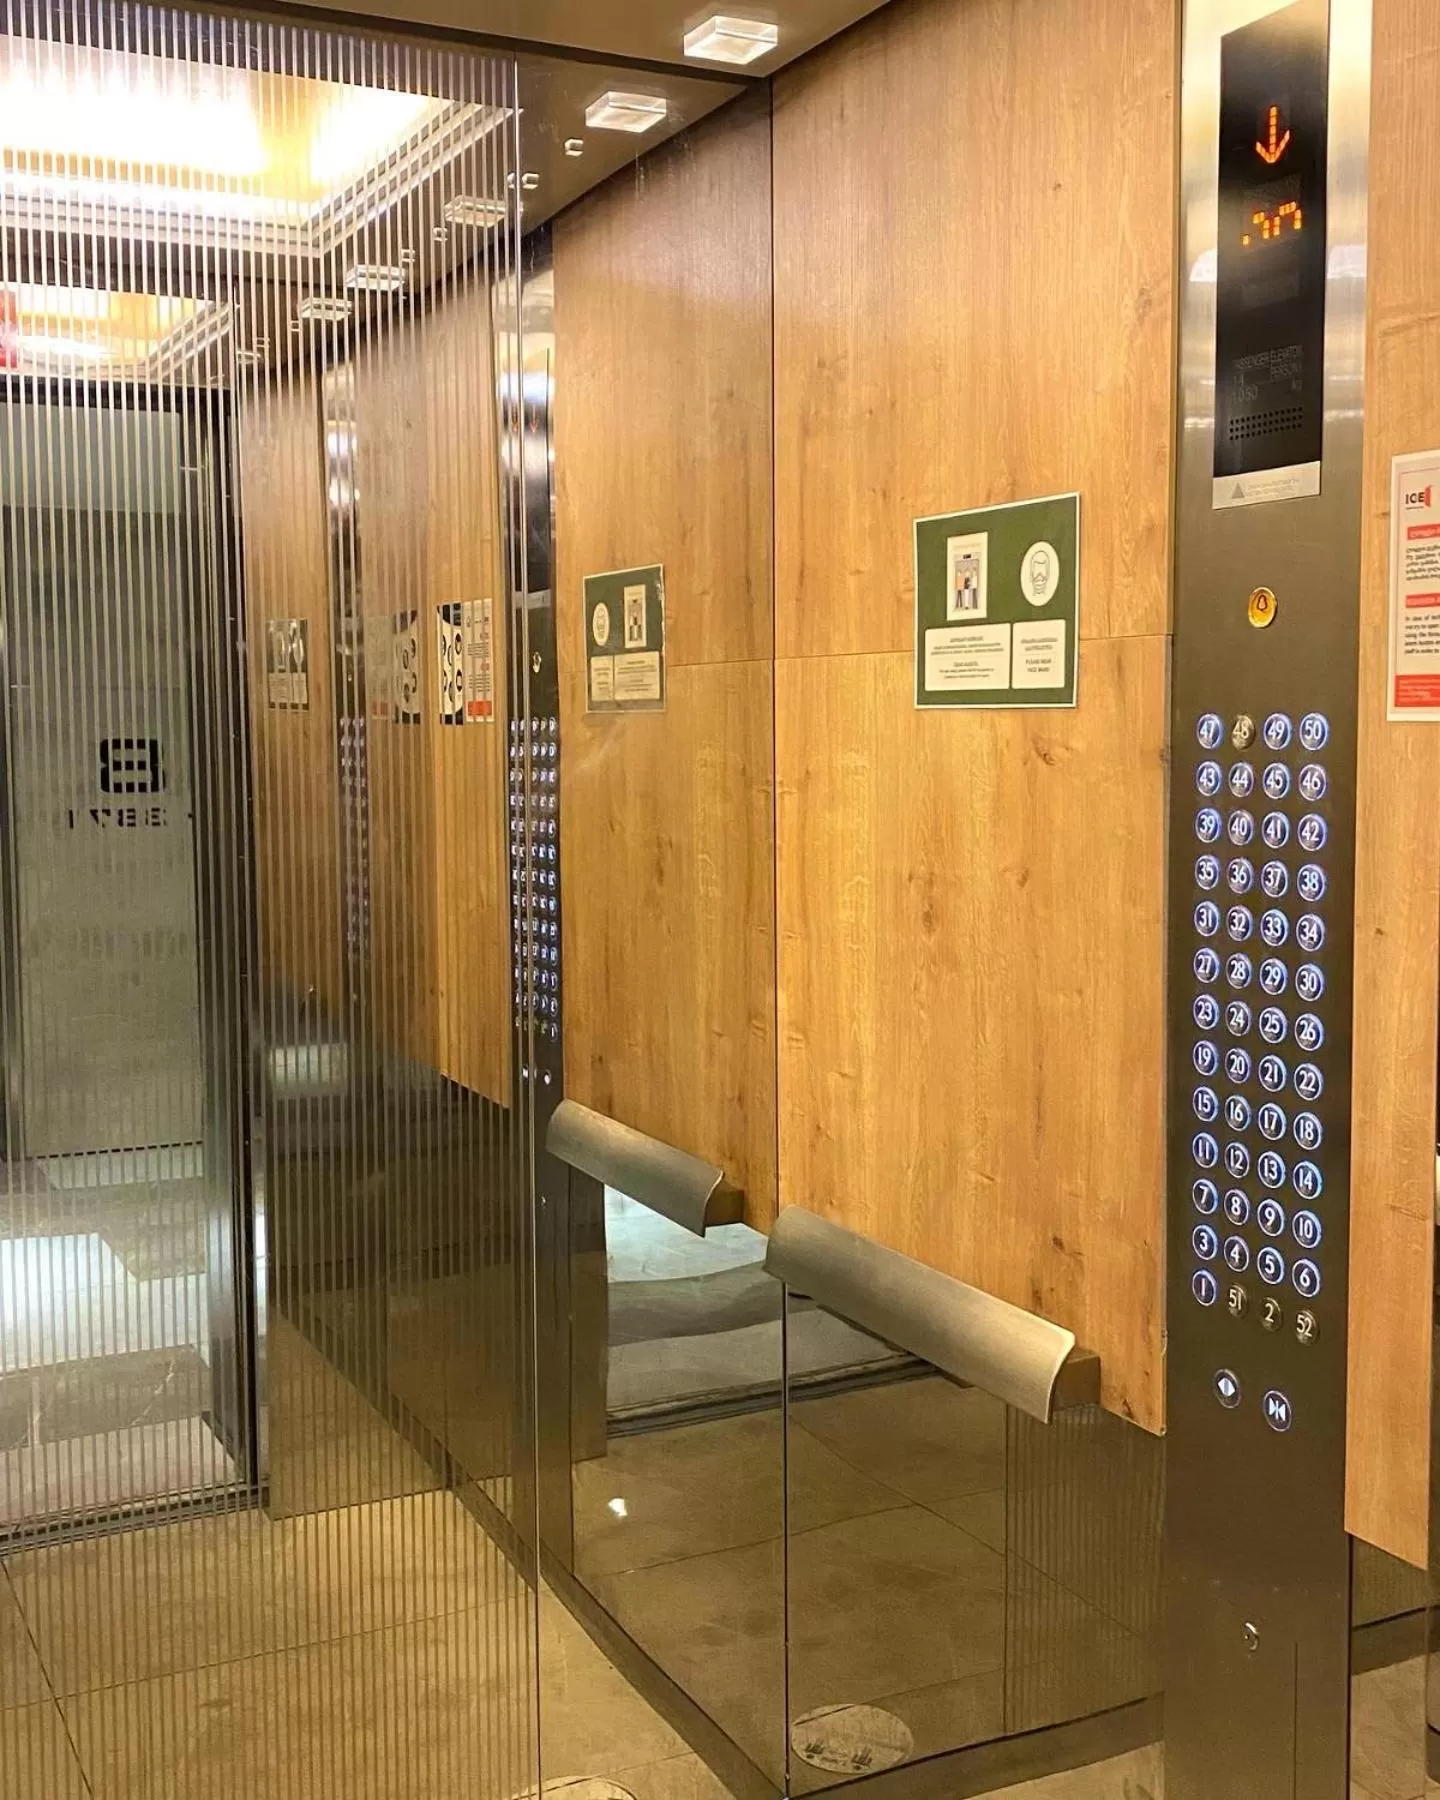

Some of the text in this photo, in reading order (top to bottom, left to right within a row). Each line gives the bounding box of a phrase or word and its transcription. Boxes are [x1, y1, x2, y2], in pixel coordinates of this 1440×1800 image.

[1405, 491, 1425, 505] ICE
[1200, 718, 1321, 739] 47 48 49 50
[1200, 767, 1321, 790] 43 44 45 46
[1200, 815, 1319, 841] 39 40 41 42
[1199, 862, 1319, 890] 35 36 37 38
[1199, 909, 1317, 941] 31 32 33 34
[1197, 957, 1316, 991] 27 28 29 30
[1198, 1003, 1316, 1041] 23 24 25 26
[1198, 1047, 1315, 1091] 19 20 21 22
[1198, 1093, 1313, 1139] 15 16 17 18
[1199, 1141, 1313, 1189] 11 12 13 14
[1200, 1186, 1312, 1238] 7 8 9 10
[1200, 1233, 1309, 1286] 3 4 5 6
[1229, 1289, 1242, 1309] 51
[1265, 1303, 1273, 1322] 2
[1297, 1315, 1312, 1337] 52
